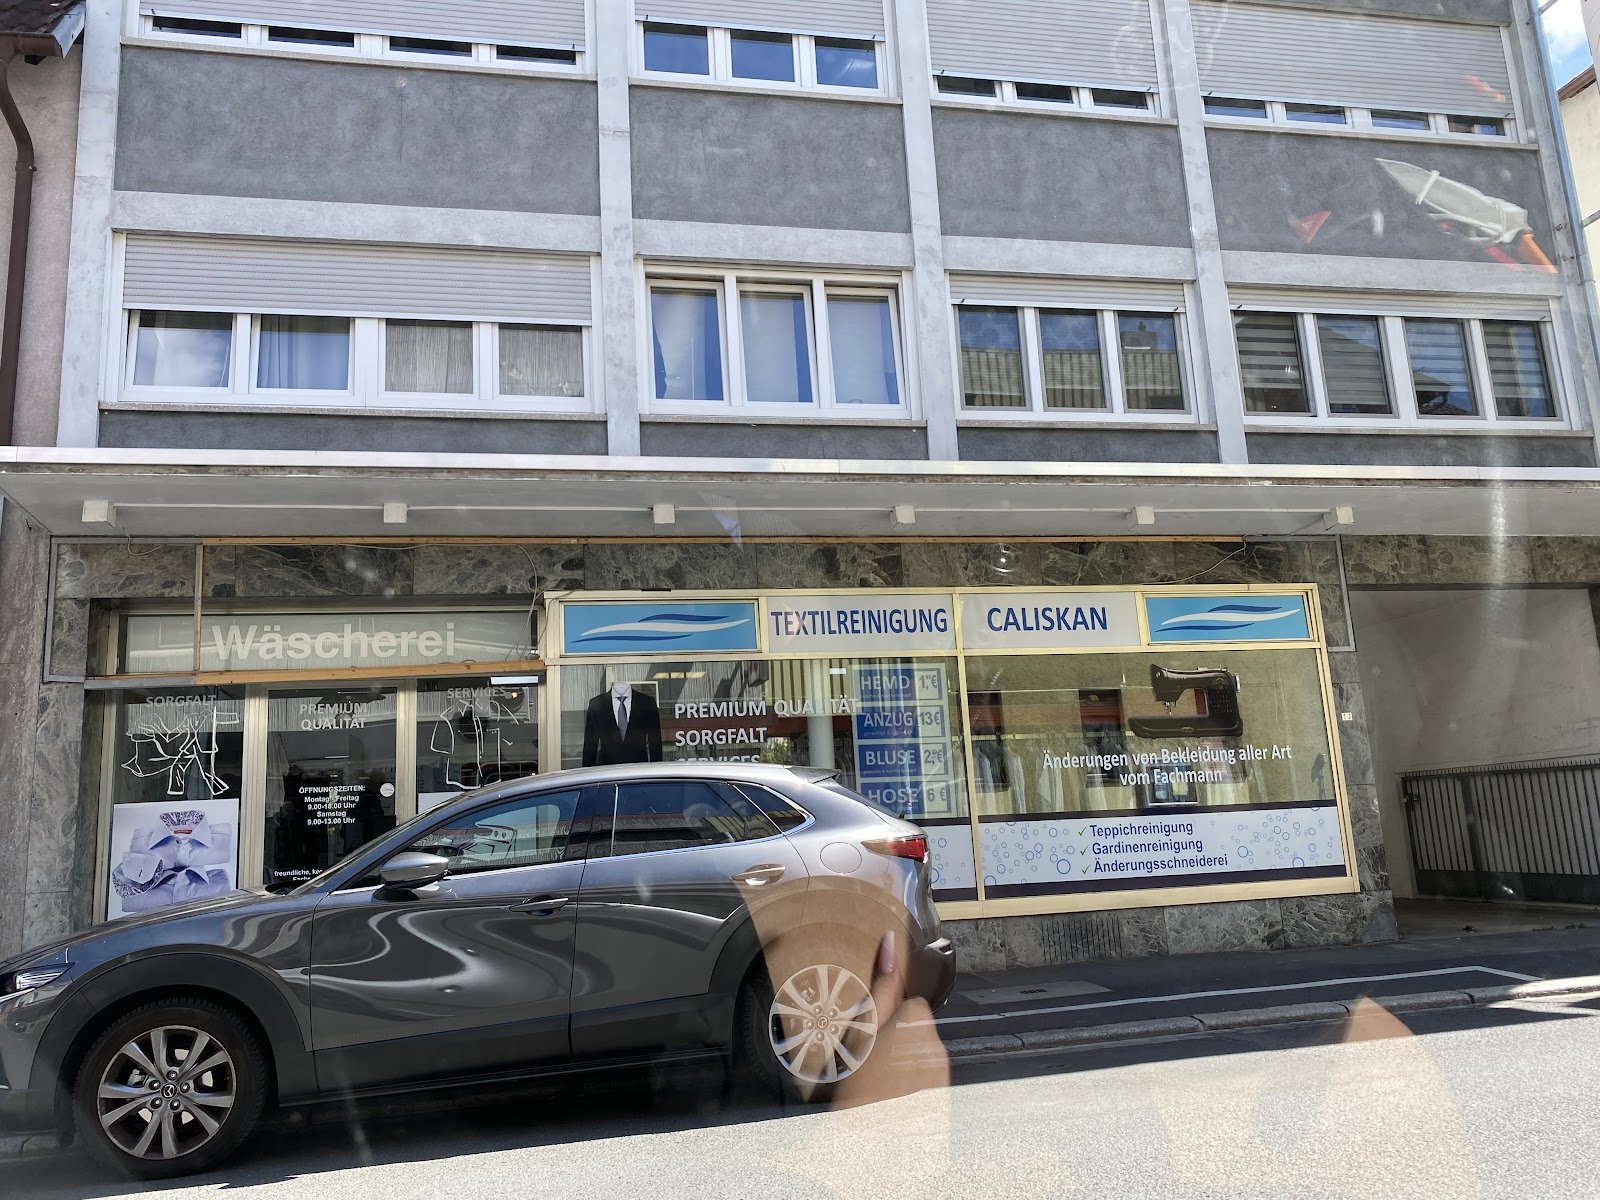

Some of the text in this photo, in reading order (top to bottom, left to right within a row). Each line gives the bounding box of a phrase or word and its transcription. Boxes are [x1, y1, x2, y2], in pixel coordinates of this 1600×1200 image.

[770, 605, 1108, 636] TEXTILREINIGUNG CALISKAN
[212, 622, 456, 660] Wäscherei
[861, 675, 911, 690] HEMD
[145, 694, 217, 707] SORGFALT
[447, 686, 506, 699] SERVICES
[299, 702, 367, 715] PREMIUM
[674, 694, 859, 719] PREMIUM QUALITÄT
[301, 714, 367, 731] QUALITÄT
[863, 711, 914, 728] ANZUG
[675, 727, 768, 747] SORGFALT
[865, 749, 916, 766] BLUSE
[1042, 744, 1293, 771] Änderungen von Bekleidung aller Art
[1119, 767, 1223, 786] vom Fachmann
[298, 784, 366, 794] ÖFFNUNGSZEITEN:
[867, 787, 919, 804] HOSE
[304, 796, 330, 804] Montag
[336, 794, 360, 802] Freitag
[343, 801, 357, 809] Uhr
[316, 810, 347, 818] Samstag
[1089, 821, 1194, 840] Teppichreinigung
[1092, 838, 1204, 856] Gardinenreinigung
[1093, 853, 1229, 873] Änderungsschneiderei
